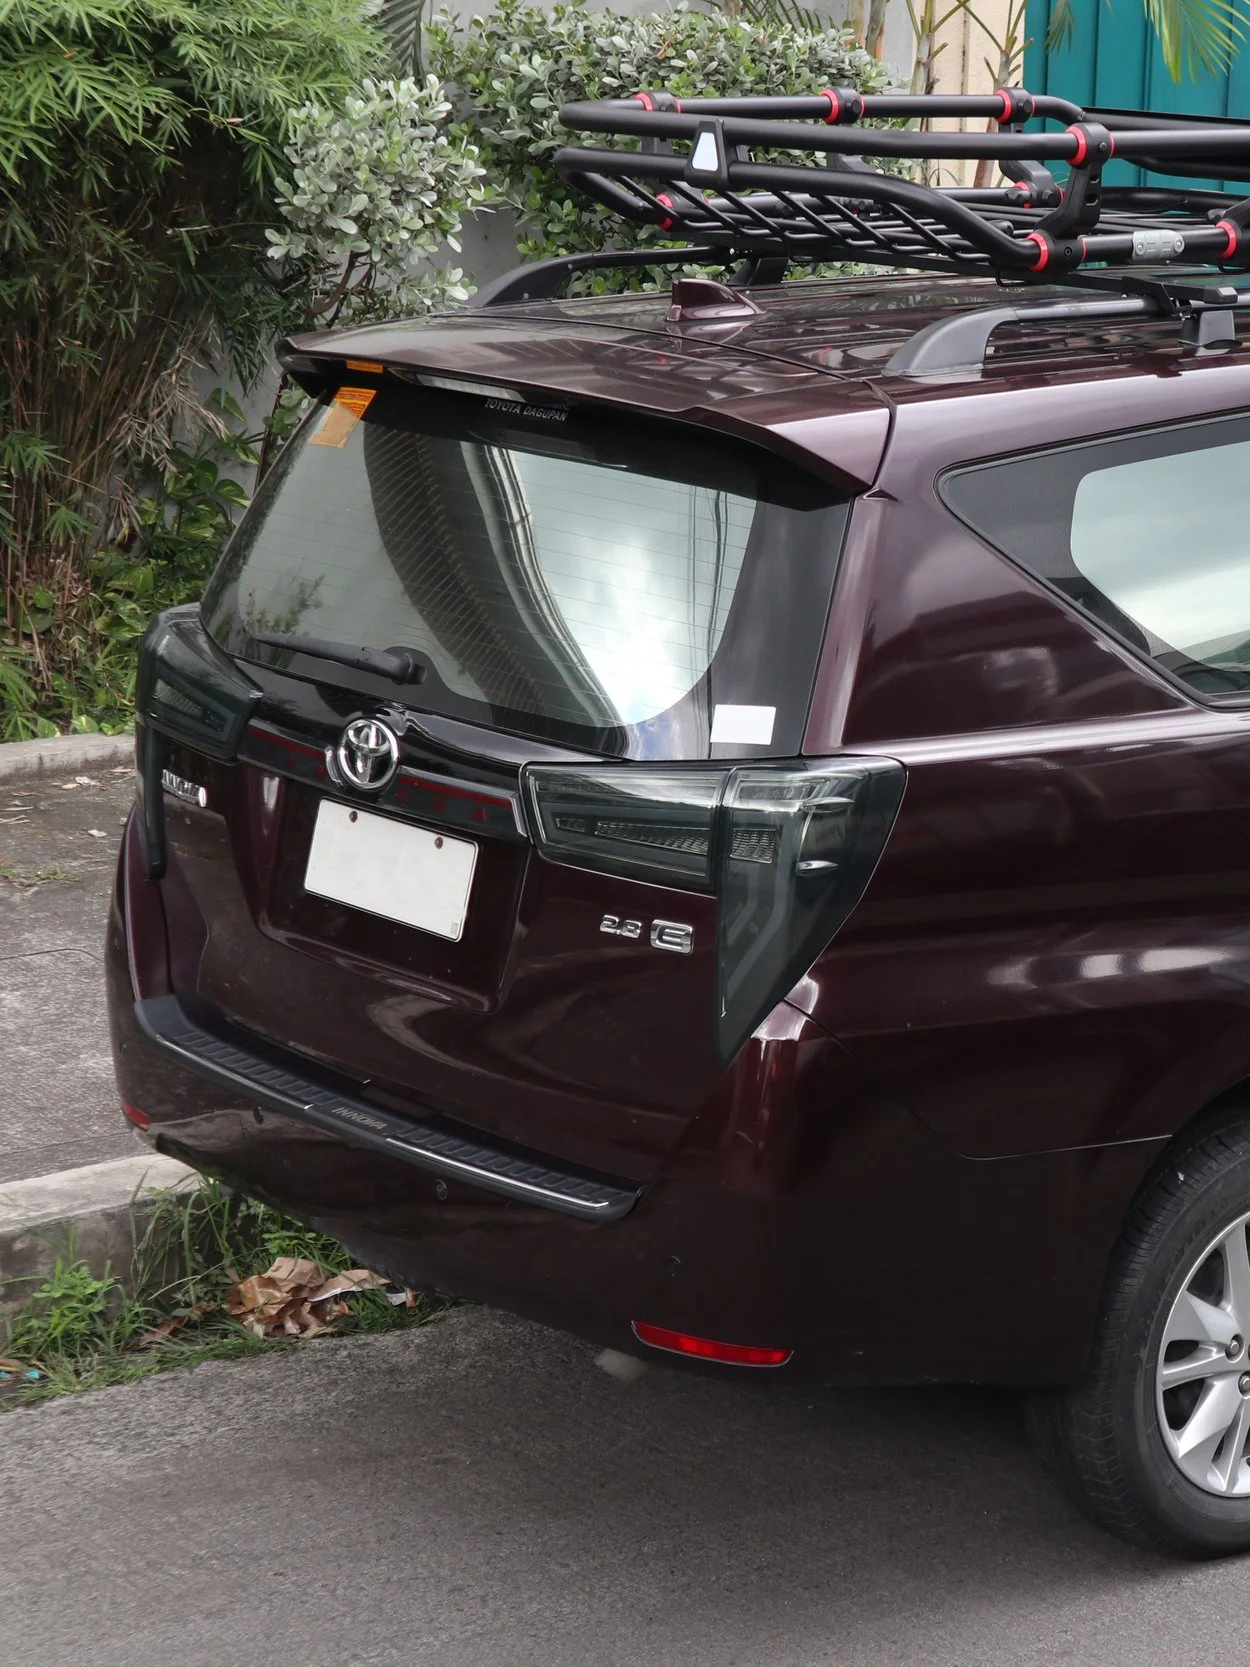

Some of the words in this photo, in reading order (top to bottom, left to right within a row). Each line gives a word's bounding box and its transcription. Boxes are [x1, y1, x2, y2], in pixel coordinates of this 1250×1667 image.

[485, 399, 521, 414] TOYOTA
[523, 406, 568, 421] DAGUPAN
[600, 914, 642, 939] 2.8
[331, 1107, 388, 1130] INNOVA
